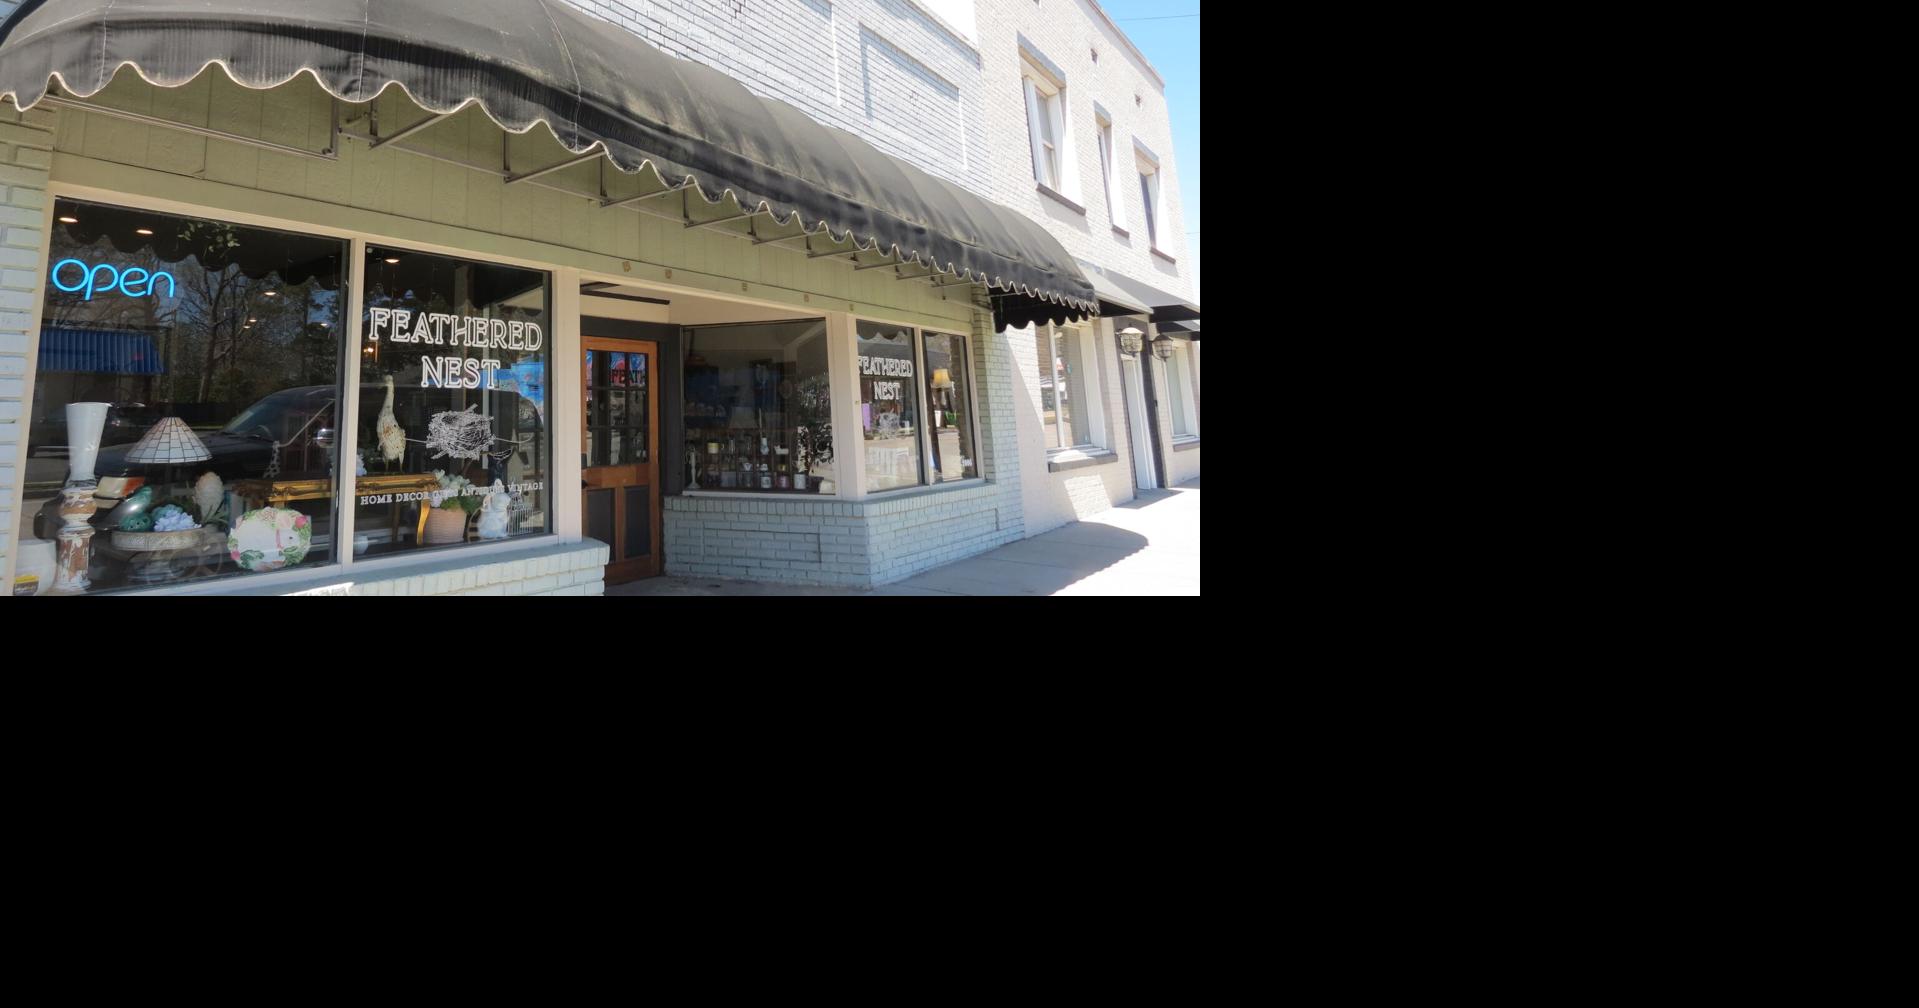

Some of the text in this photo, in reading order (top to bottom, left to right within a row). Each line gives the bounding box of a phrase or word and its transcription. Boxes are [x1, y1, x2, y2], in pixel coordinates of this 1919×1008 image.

[368, 308, 543, 351] FEATHERED
[420, 355, 501, 389] NEST
[873, 381, 901, 400] NEST
[360, 494, 392, 506] HOME
[396, 490, 430, 502] DECOR
[507, 481, 544, 493] VINTAGE
